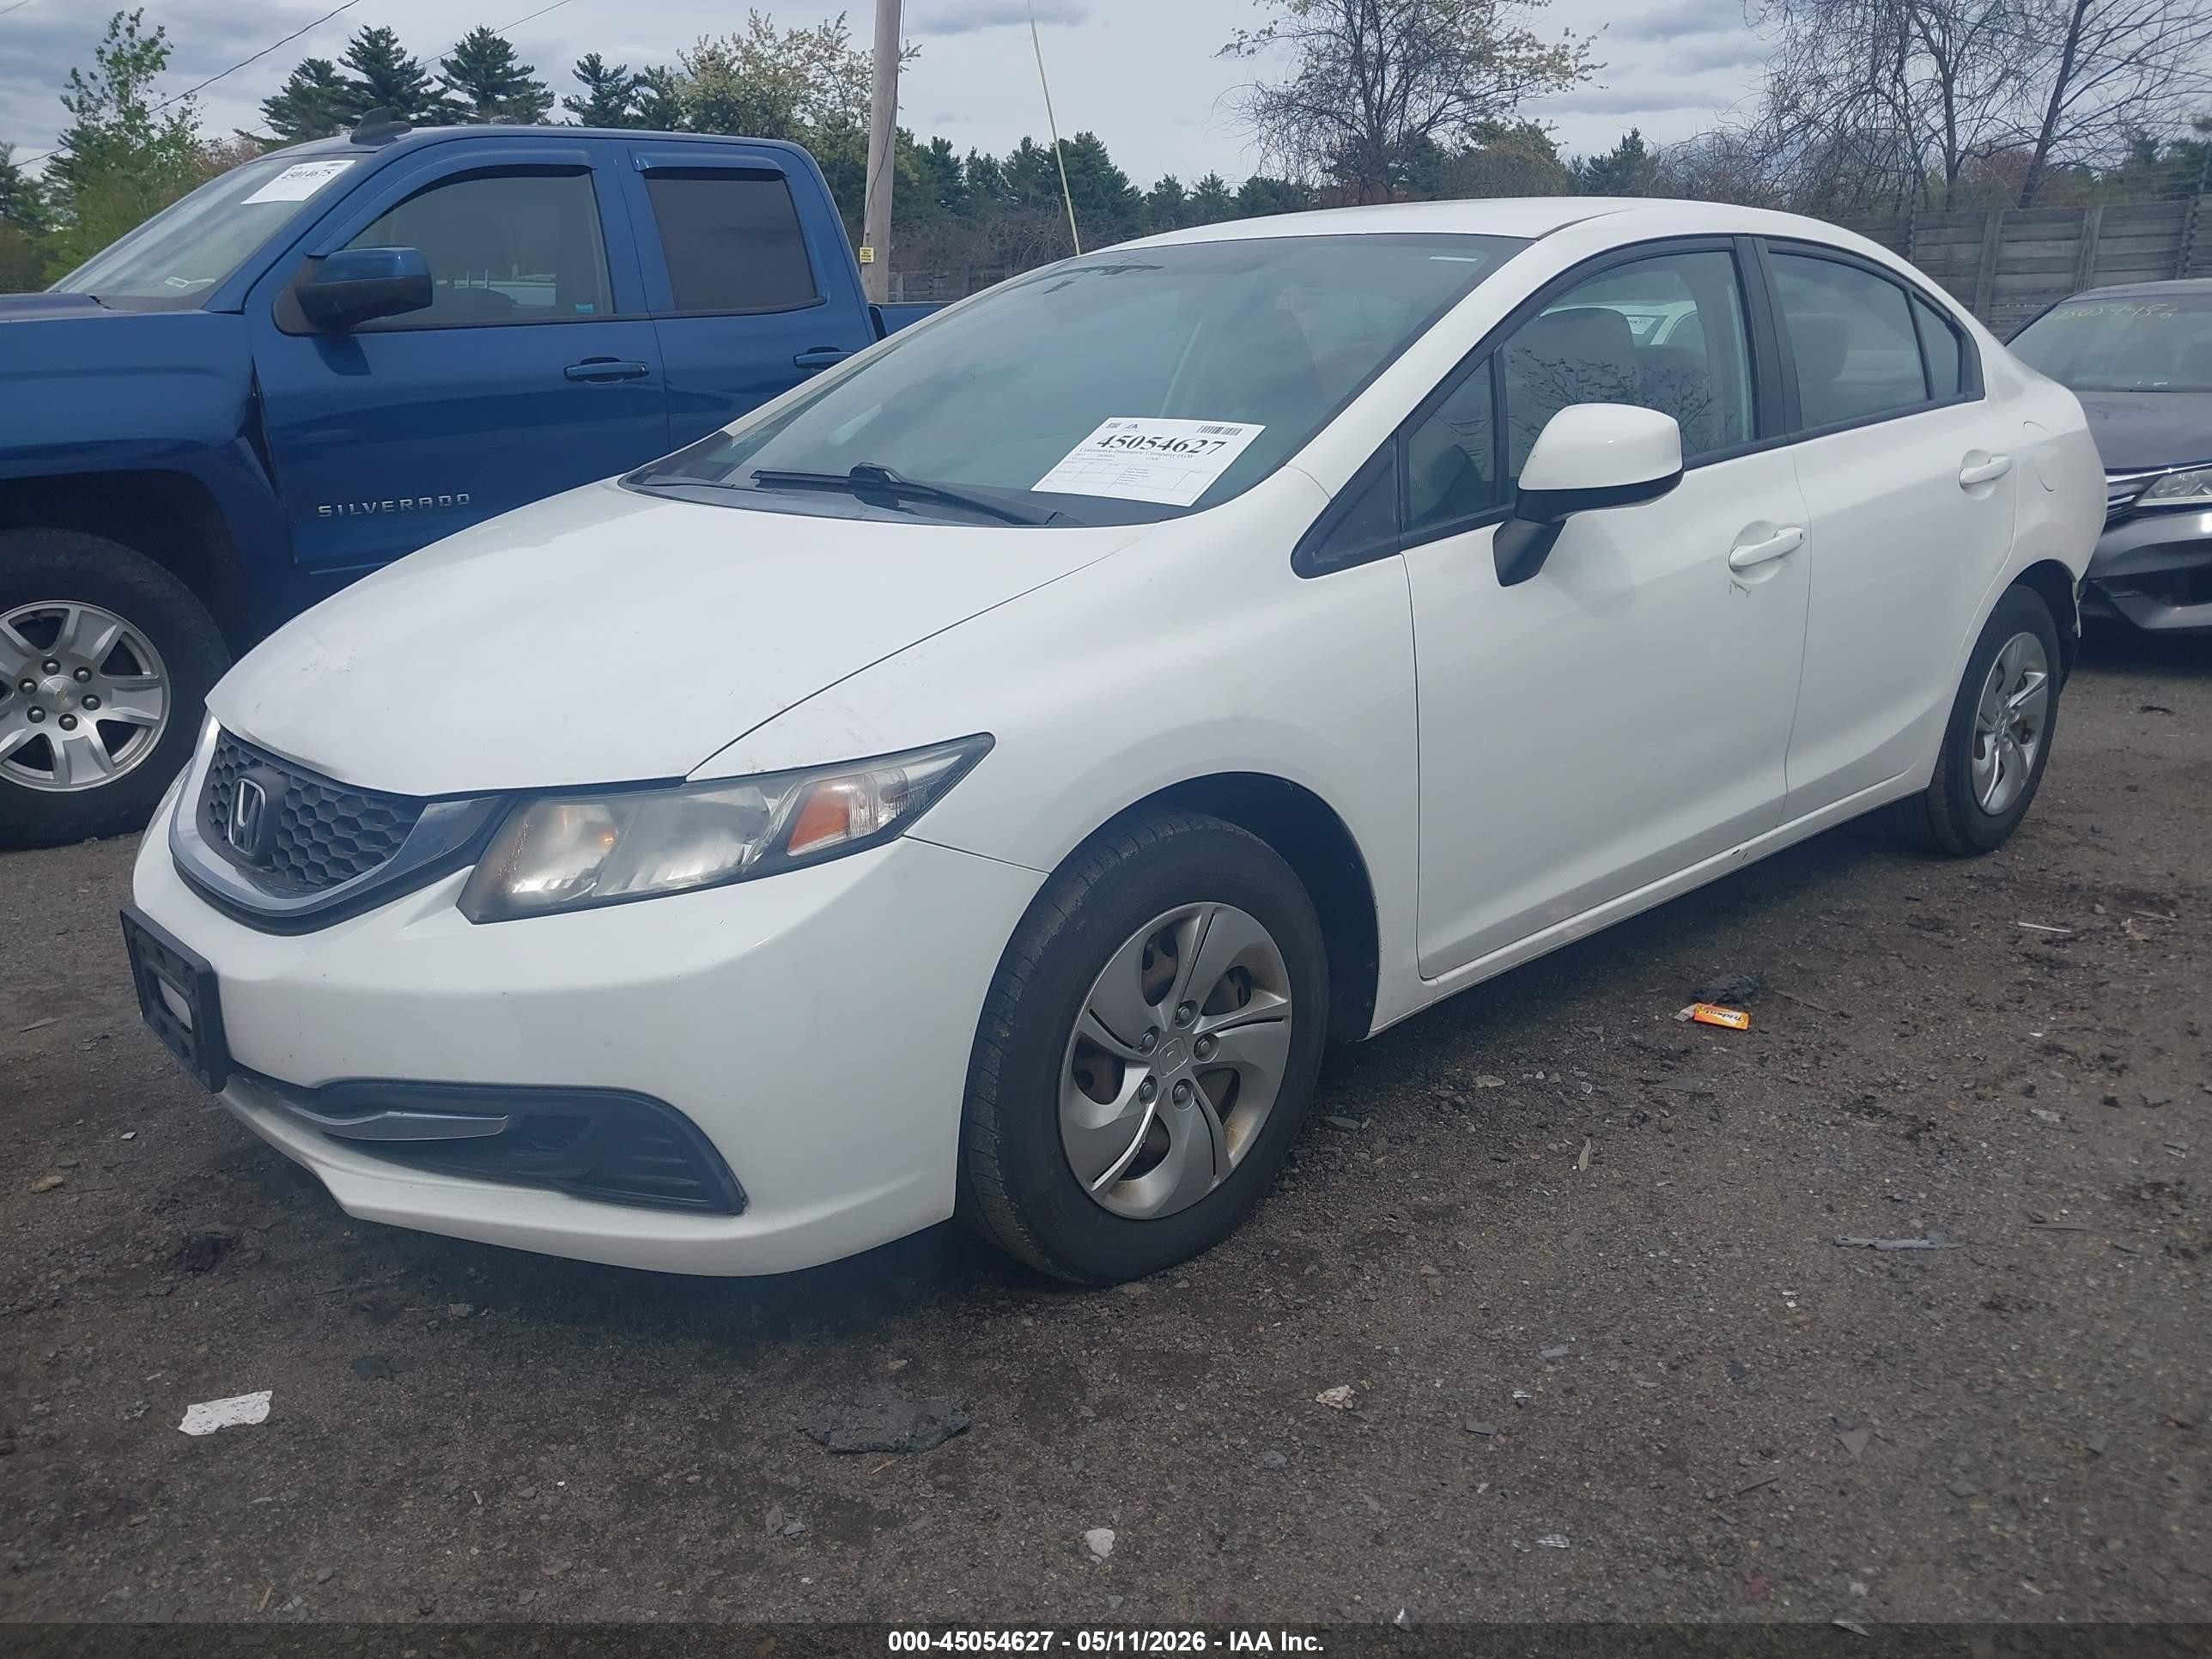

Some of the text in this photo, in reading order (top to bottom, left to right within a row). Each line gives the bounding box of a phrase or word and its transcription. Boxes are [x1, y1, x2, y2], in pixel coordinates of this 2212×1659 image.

[1096, 434, 1229, 456] 45054627
[317, 492, 471, 518] SILVERADO
[1704, 1010, 1742, 1021] Trident
